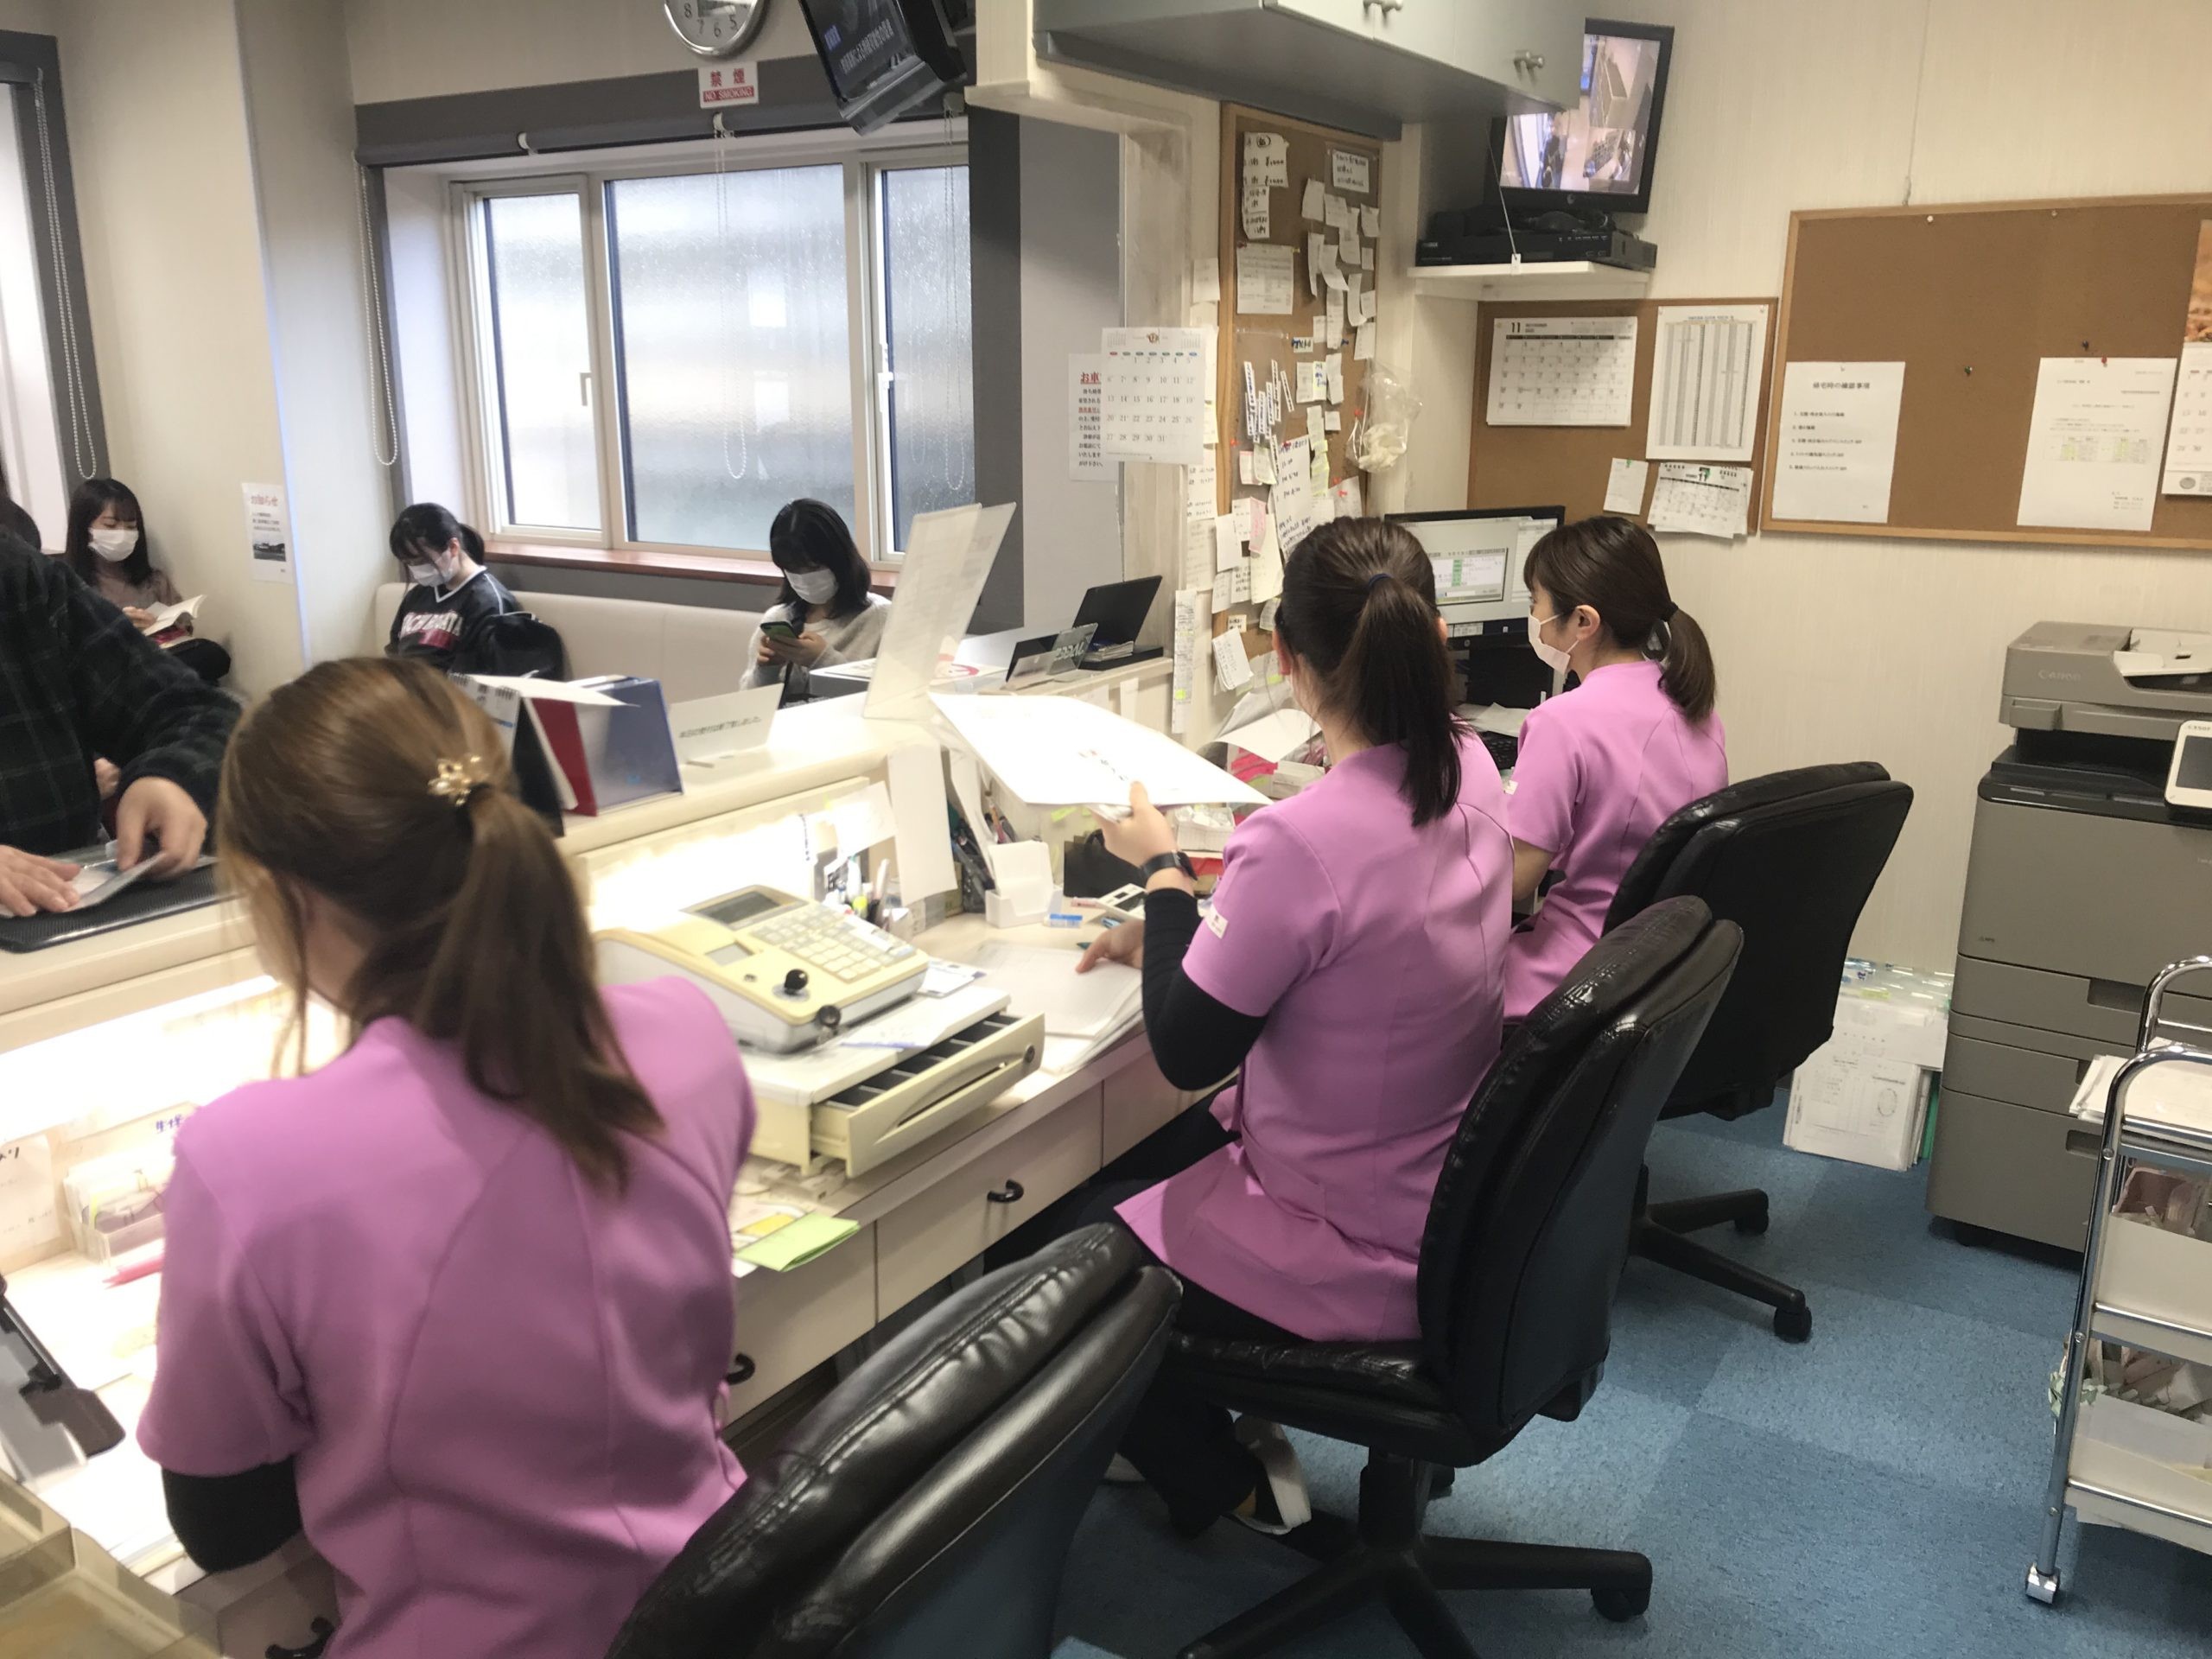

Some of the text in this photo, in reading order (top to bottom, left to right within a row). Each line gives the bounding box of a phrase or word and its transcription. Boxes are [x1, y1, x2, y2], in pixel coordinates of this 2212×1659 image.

[684, 3, 691, 18] 8
[697, 18, 704, 34] 7
[714, 22, 721, 37] 6
[729, 15, 737, 29] 5
[704, 86, 753, 101] NO SMOKING
[1511, 322, 1521, 333] 11
[2037, 669, 2082, 681] Canon
